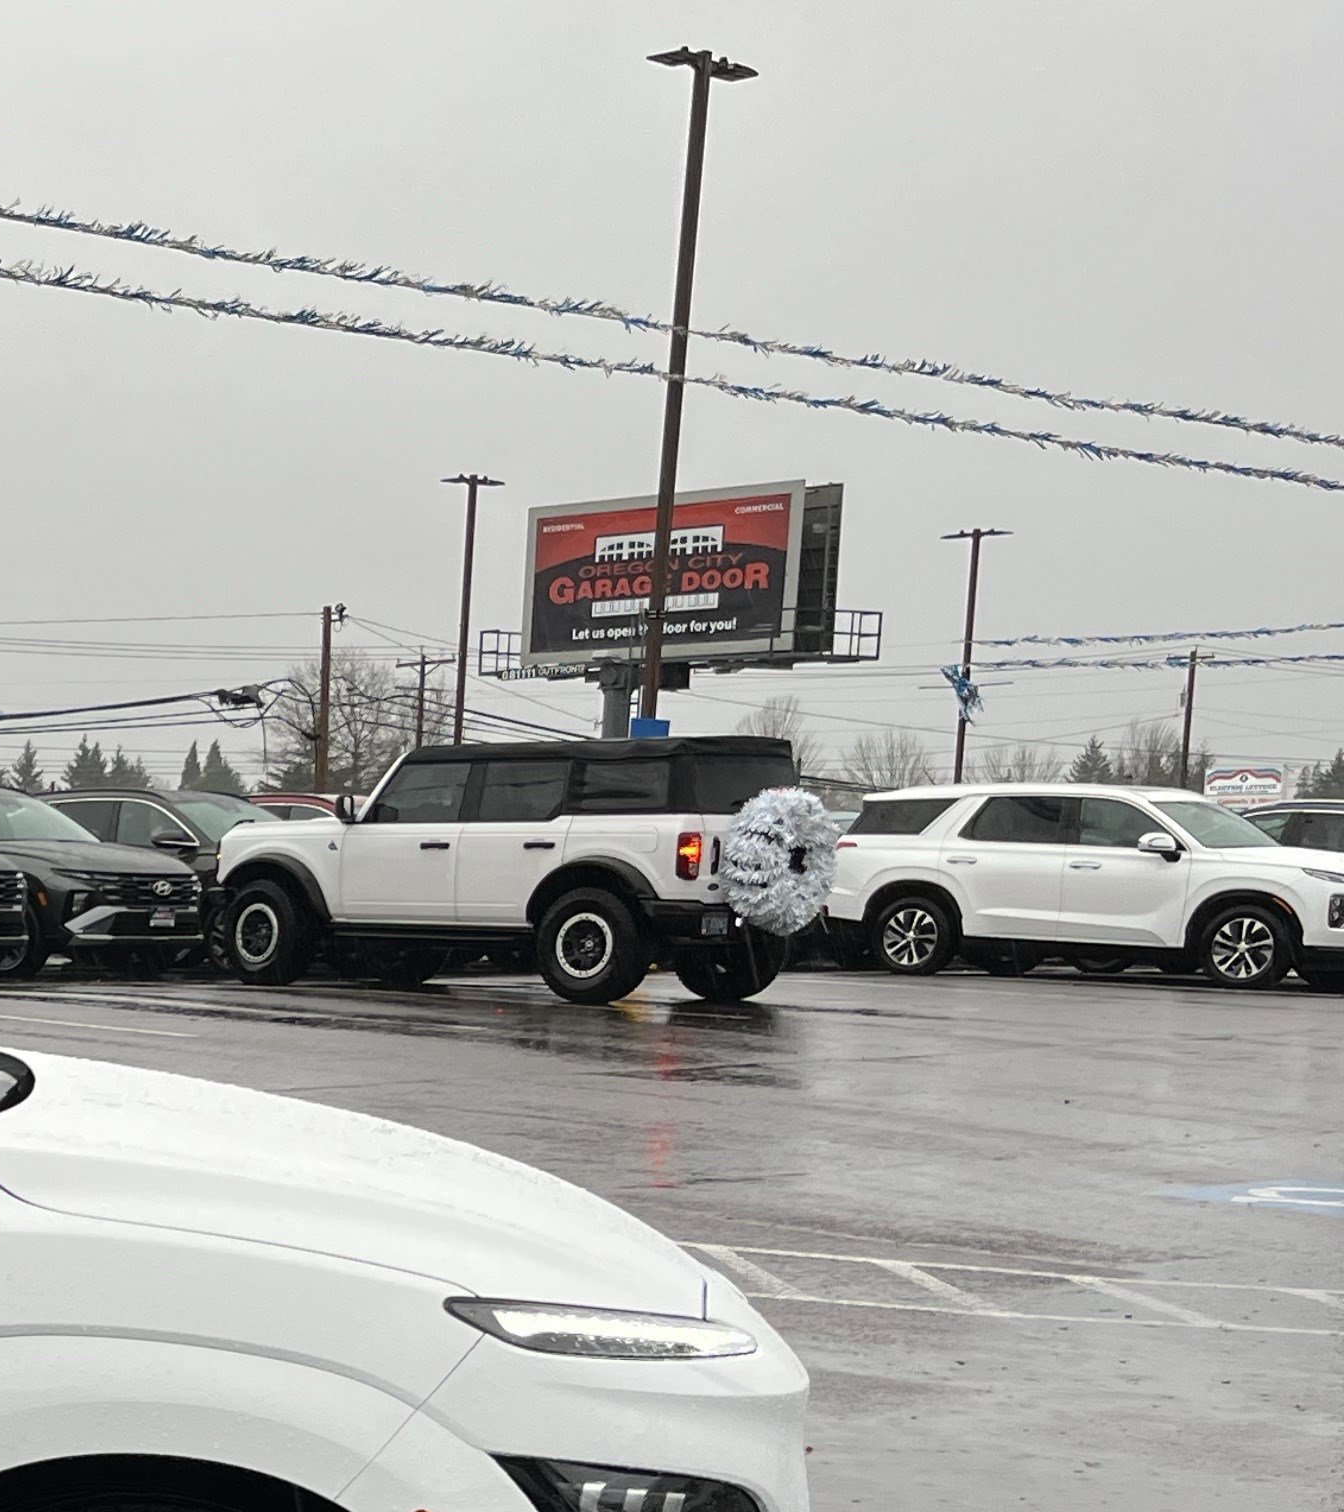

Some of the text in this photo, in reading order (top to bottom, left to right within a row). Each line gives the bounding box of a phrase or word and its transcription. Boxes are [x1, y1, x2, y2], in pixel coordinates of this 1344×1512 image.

[734, 502, 784, 515] COMMERCIAL
[688, 552, 744, 569] CITY
[549, 561, 770, 605] GARAG DOOR
[572, 627, 590, 640] Let
[592, 628, 605, 639] us
[607, 626, 636, 640] open
[689, 619, 708, 633] for
[709, 617, 737, 634] you!
